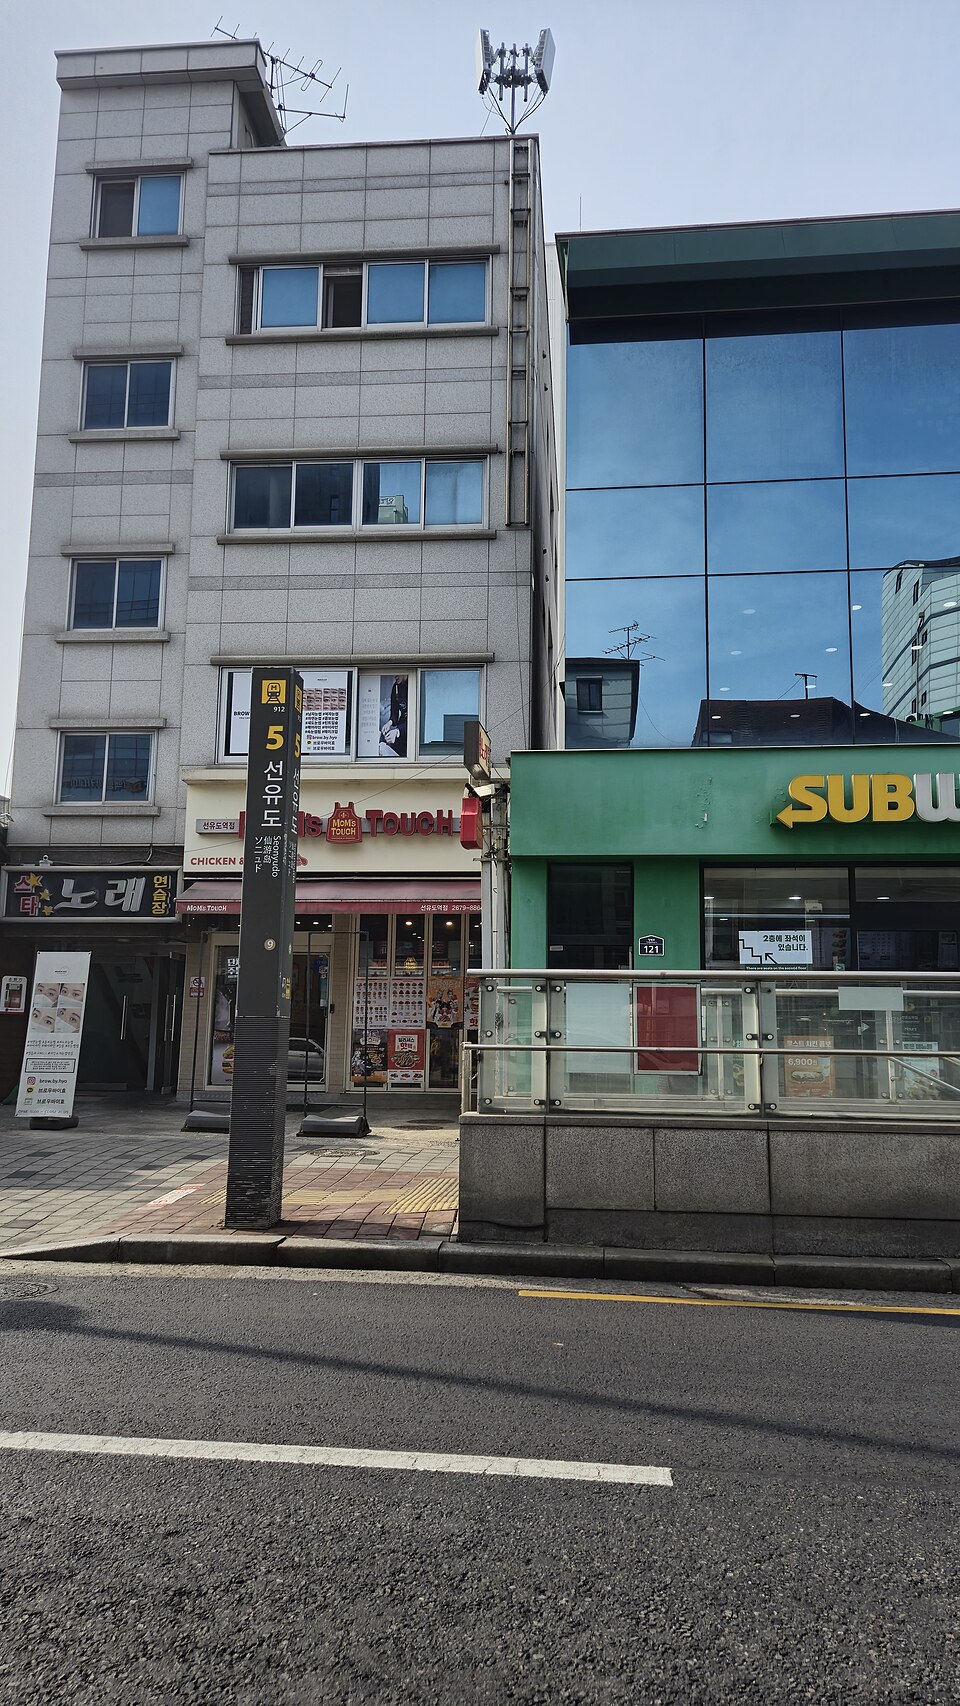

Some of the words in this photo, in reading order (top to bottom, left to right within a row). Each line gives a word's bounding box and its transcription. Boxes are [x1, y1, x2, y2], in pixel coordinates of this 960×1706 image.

[265, 725, 284, 750] 5
[261, 760, 283, 827] 선유도
[202, 821, 235, 830] 선유도역점
[331, 827, 356, 836] TOUCH
[366, 809, 453, 838] TOUCH
[190, 857, 236, 866] CHICKEN
[271, 836, 282, 878] Seonyudo
[14, 875, 39, 916] 스타
[54, 876, 146, 912] 노래
[152, 875, 170, 914] 연습장
[267, 940, 273, 949] 9
[763, 934, 782, 942] 2층에
[784, 934, 806, 942] 좌석이
[643, 945, 659, 953] 121
[777, 943, 809, 951] 있습니다.
